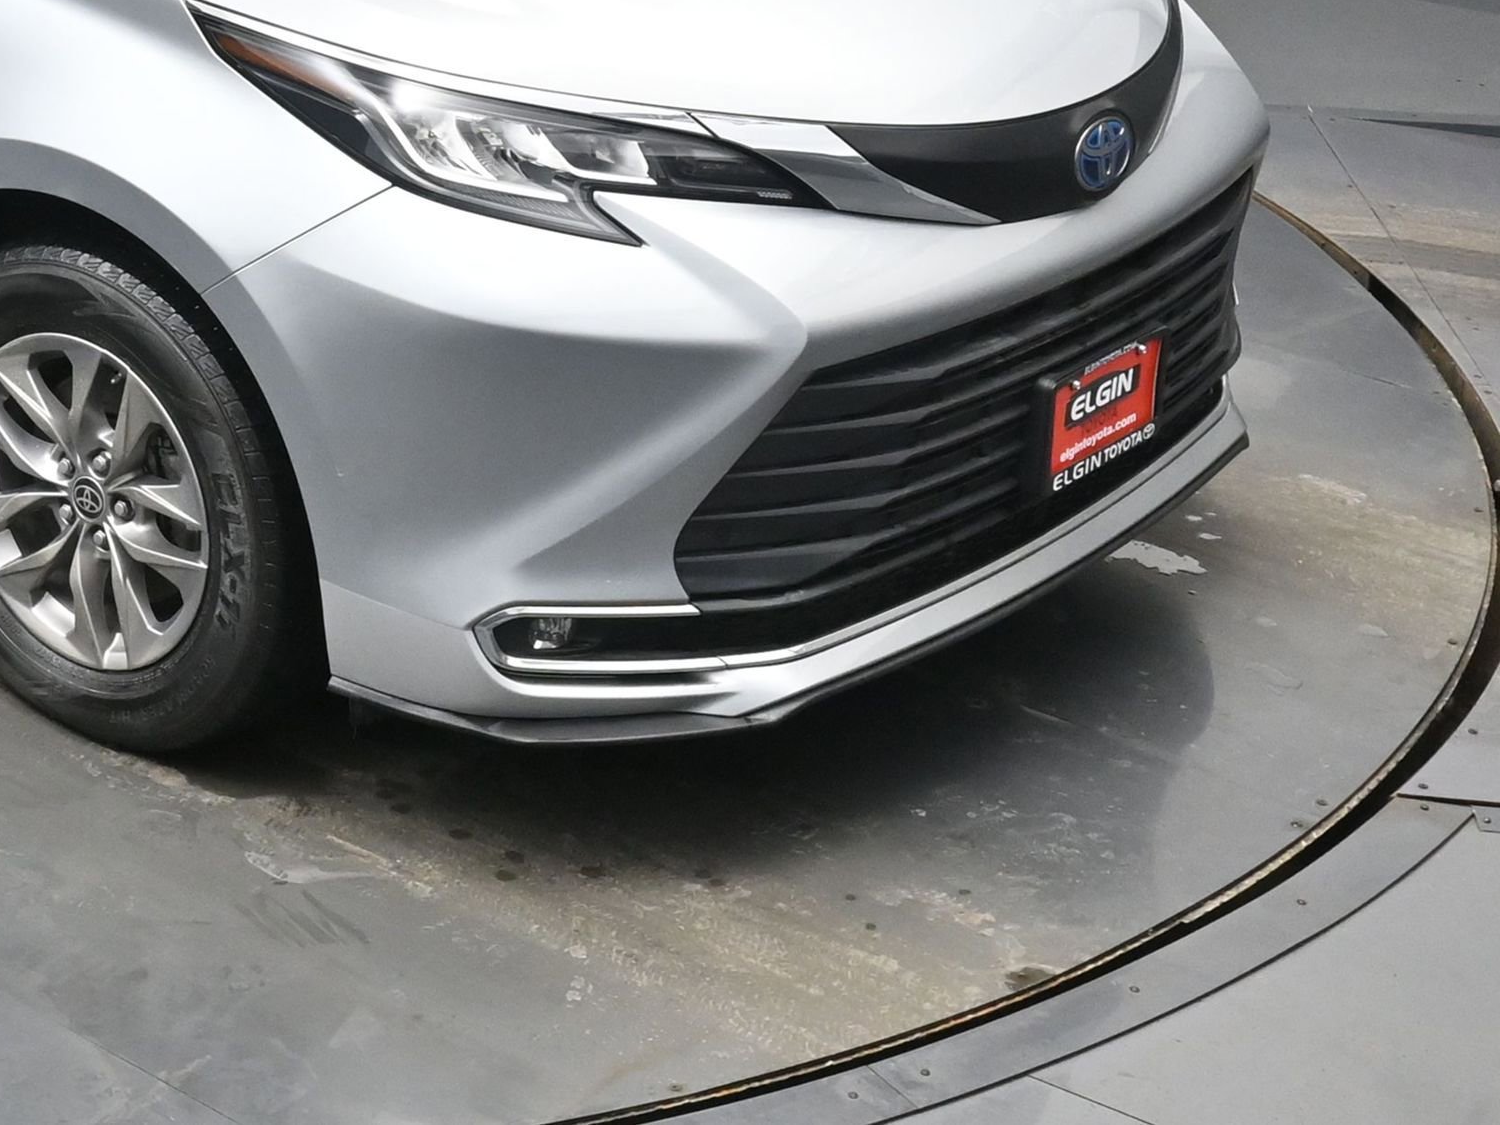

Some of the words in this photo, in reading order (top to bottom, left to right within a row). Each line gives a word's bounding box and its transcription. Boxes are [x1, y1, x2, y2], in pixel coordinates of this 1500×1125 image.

[1070, 367, 1134, 421] ELGIN
[1052, 451, 1102, 492] ELGIN
[1104, 430, 1143, 464] TOYOTA
[1059, 412, 1137, 463] elgintoyota.com
